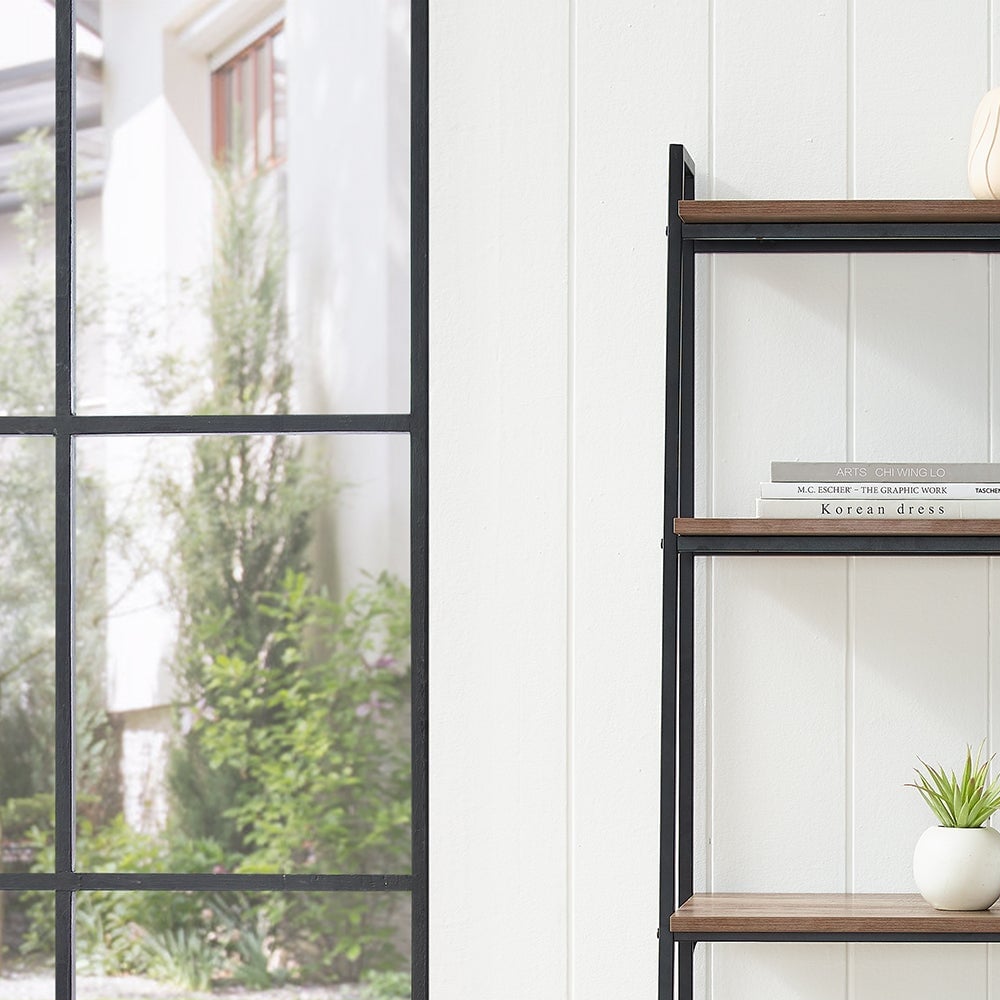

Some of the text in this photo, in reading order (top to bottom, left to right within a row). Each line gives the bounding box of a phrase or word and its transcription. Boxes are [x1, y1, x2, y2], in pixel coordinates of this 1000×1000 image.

[836, 467, 946, 478] ARTS CHI WING LO
[797, 486, 816, 494] M.C.
[860, 486, 879, 494] THE
[880, 486, 919, 494] GRAPHIC
[921, 486, 948, 494] WORK
[821, 503, 945, 515] Korean dress
